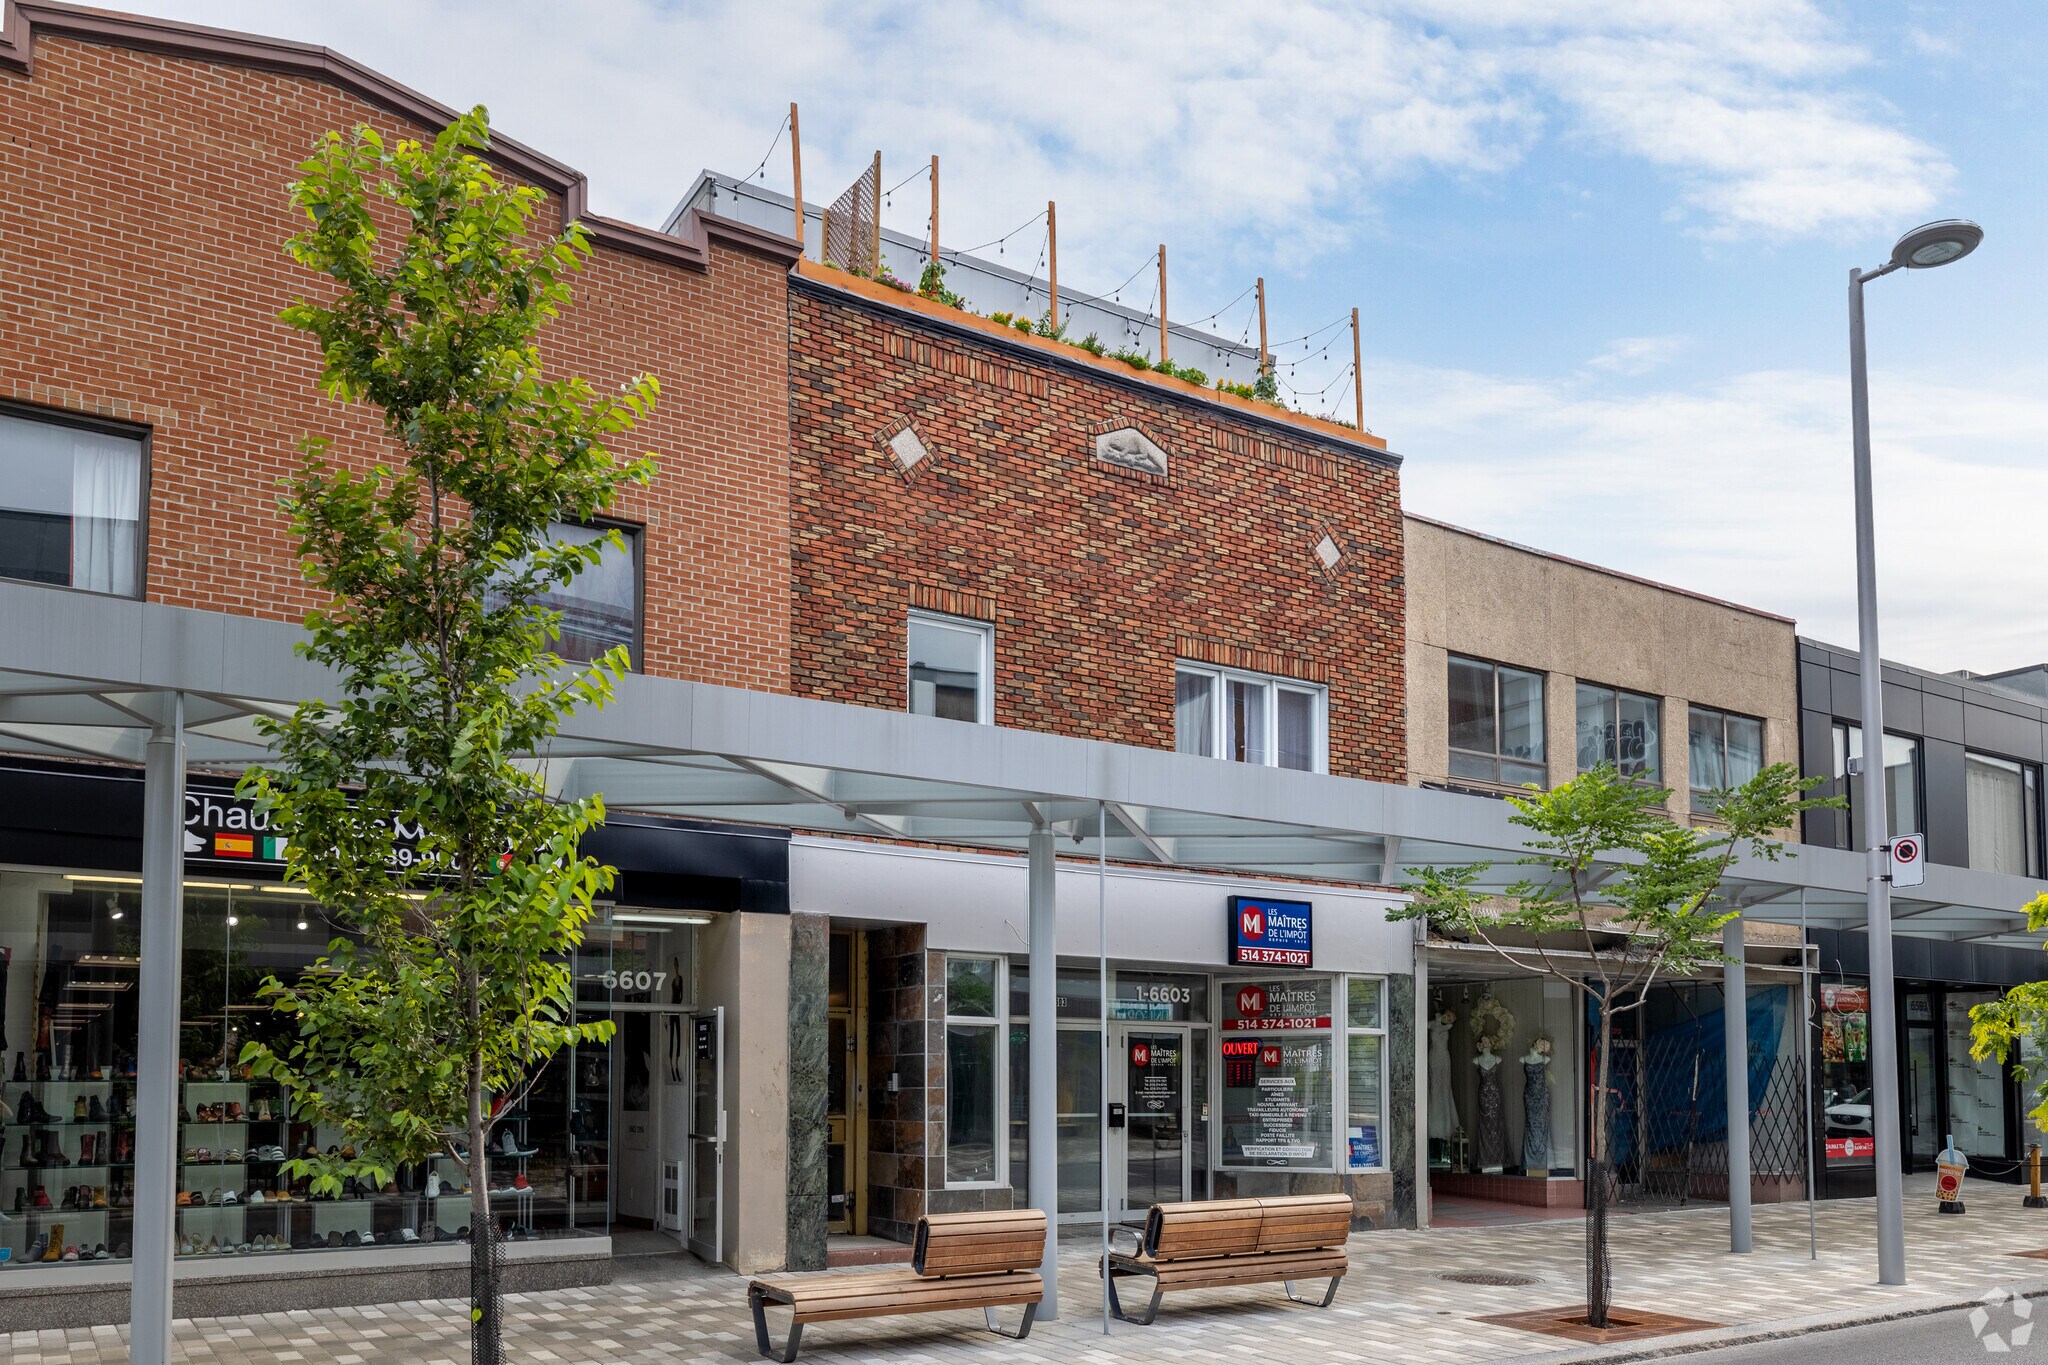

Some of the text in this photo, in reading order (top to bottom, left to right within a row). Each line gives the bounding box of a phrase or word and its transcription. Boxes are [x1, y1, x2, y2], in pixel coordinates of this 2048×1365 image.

[1268, 915, 1307, 928] MAÎTRES
[1268, 929, 1307, 939] DE L'IMPÔT
[1242, 950, 1307, 963] 514 374-1021
[603, 970, 667, 991] 6607
[1136, 986, 1190, 1002] 1-6603
[1270, 990, 1316, 1002] MAÎTRES
[1283, 1002, 1316, 1012] L'IMPÔT
[1238, 1019, 1316, 1029] 514 374-1021
[1151, 1049, 1176, 1057] MAÎTRES
[1223, 1042, 1258, 1055] OUVERT
[1283, 1049, 1322, 1057] MAÎTRES
